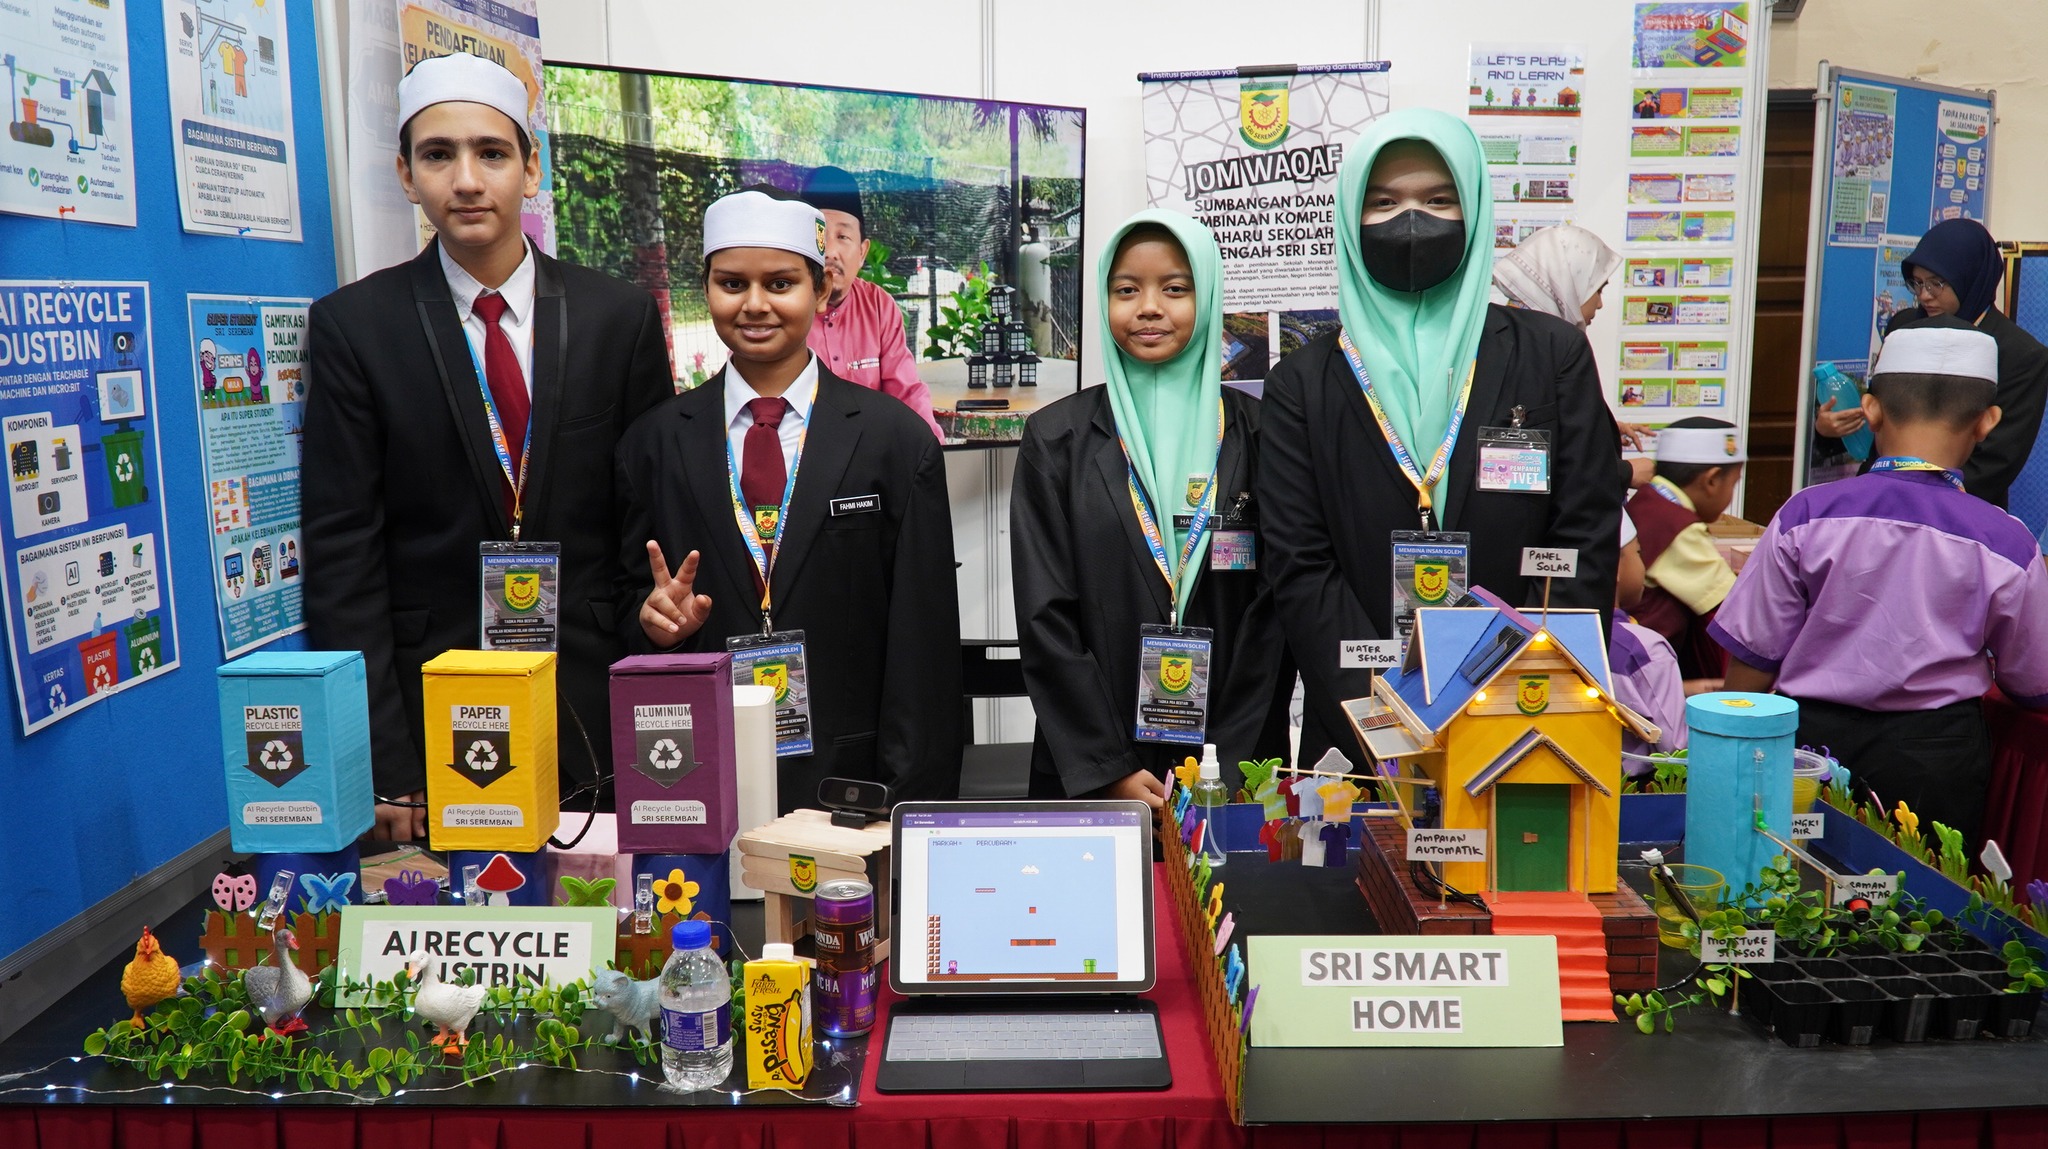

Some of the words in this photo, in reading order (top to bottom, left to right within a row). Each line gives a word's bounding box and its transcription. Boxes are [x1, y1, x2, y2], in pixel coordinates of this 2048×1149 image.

[490, 3, 508, 19] SETIA
[426, 20, 506, 67] PENDAFTARAN
[1488, 56, 1526, 66] LET'S
[1530, 56, 1567, 66] PLAY
[1180, 70, 1220, 79] pendidikan
[1297, 64, 1331, 73] emerlang
[1488, 71, 1515, 80] AND
[1520, 71, 1565, 81] LEARN
[187, 128, 224, 144] BAGAIMANA
[224, 136, 246, 149] SISTEM
[1245, 125, 1255, 136] SRI
[1254, 123, 1284, 140] SEREMBAN
[1185, 157, 1242, 200] JOM
[1242, 144, 1342, 186] WAQAF
[1194, 195, 1291, 212] SUMBANGAN
[1296, 194, 1335, 208] DANA
[1192, 212, 1270, 229] MBINAAN
[1275, 210, 1335, 225] KOMPLE
[1214, 230, 1263, 244] AHARU
[1268, 227, 1334, 241] SEKOLAH
[1222, 246, 1272, 260] ENGAH
[1276, 244, 1306, 257] SERI
[1310, 243, 1337, 256] SETI
[0, 292, 16, 326] AI
[25, 292, 132, 324] RECYCLE
[264, 314, 306, 329] GAMIFIKASI
[273, 332, 298, 346] DALAM
[219, 355, 243, 368] SAINS
[266, 349, 309, 364] PENDIDIKAN
[24, 372, 51, 384] DENGAN
[53, 369, 89, 382] TEACHABLE
[0, 388, 31, 400] MACHINE
[33, 386, 47, 397] DAN
[48, 382, 81, 396] MICRO:BIT
[8, 417, 48, 432] KOMPONEN
[1441, 435, 1455, 456] INSAN
[1449, 414, 1461, 436] SOLEH
[1510, 465, 1541, 473] PEMPAMER
[51, 474, 78, 485] SERVOMOTOR
[1512, 472, 1539, 485] TVET
[16, 482, 39, 493] MICRO:BIT
[840, 502, 857, 511] FAHMI
[856, 500, 874, 509] HAKIM
[42, 516, 61, 527] KAMERA
[1194, 513, 1206, 533] SOLEH
[231, 532, 251, 545] APAKAH
[252, 526, 277, 541] KELEBIHAN
[1141, 510, 1156, 541] SEKOLAH
[1152, 538, 1162, 552] SRI
[20, 545, 59, 564] BAGAIMANA
[60, 540, 81, 554] SISTEM
[82, 538, 91, 547] INI
[92, 529, 125, 545] BERFUNGSI
[1232, 553, 1251, 565] TVET
[1529, 550, 1562, 561] PANEL
[69, 566, 77, 581] AI
[1536, 562, 1572, 573] SOLAR
[130, 630, 160, 649] ALUMINIUM
[1146, 640, 1172, 648] MEMBINA
[87, 649, 112, 665] PLASTIK
[735, 652, 762, 660] MEMBINA
[762, 648, 780, 657] INSAN
[780, 646, 799, 654] SOLEH
[1346, 645, 1381, 655] WATER
[1358, 653, 1398, 664] SENSOR
[43, 667, 65, 684] KERTAS
[246, 708, 299, 720] PLASTIC
[460, 706, 502, 720] PAPER
[635, 706, 692, 718] ALUMINIUM
[246, 722, 280, 730] RECYCLE
[281, 722, 302, 730] HERE
[453, 721, 487, 729] RECYCLE
[489, 721, 510, 730] HERE
[636, 720, 670, 729] RECYCLE
[672, 720, 692, 728] HERE
[256, 806, 285, 814] Recycle
[288, 805, 318, 813] Dustbin
[457, 808, 486, 817] Recycle
[489, 808, 519, 816] Dustbin
[643, 805, 672, 814] Recycle
[456, 818, 469, 826] SRI
[1792, 819, 1819, 828] NGKI
[1855, 890, 1891, 899] INTAR
[424, 931, 570, 958] RECYCLE
[816, 930, 841, 946] ONDA
[1708, 936, 1768, 946] MOSTURE
[1718, 948, 1766, 958] SSOR
[1308, 952, 1363, 981] SRI
[1372, 952, 1502, 982] SMART
[816, 974, 840, 993] OCHA
[1353, 1000, 1461, 1030] HOME
